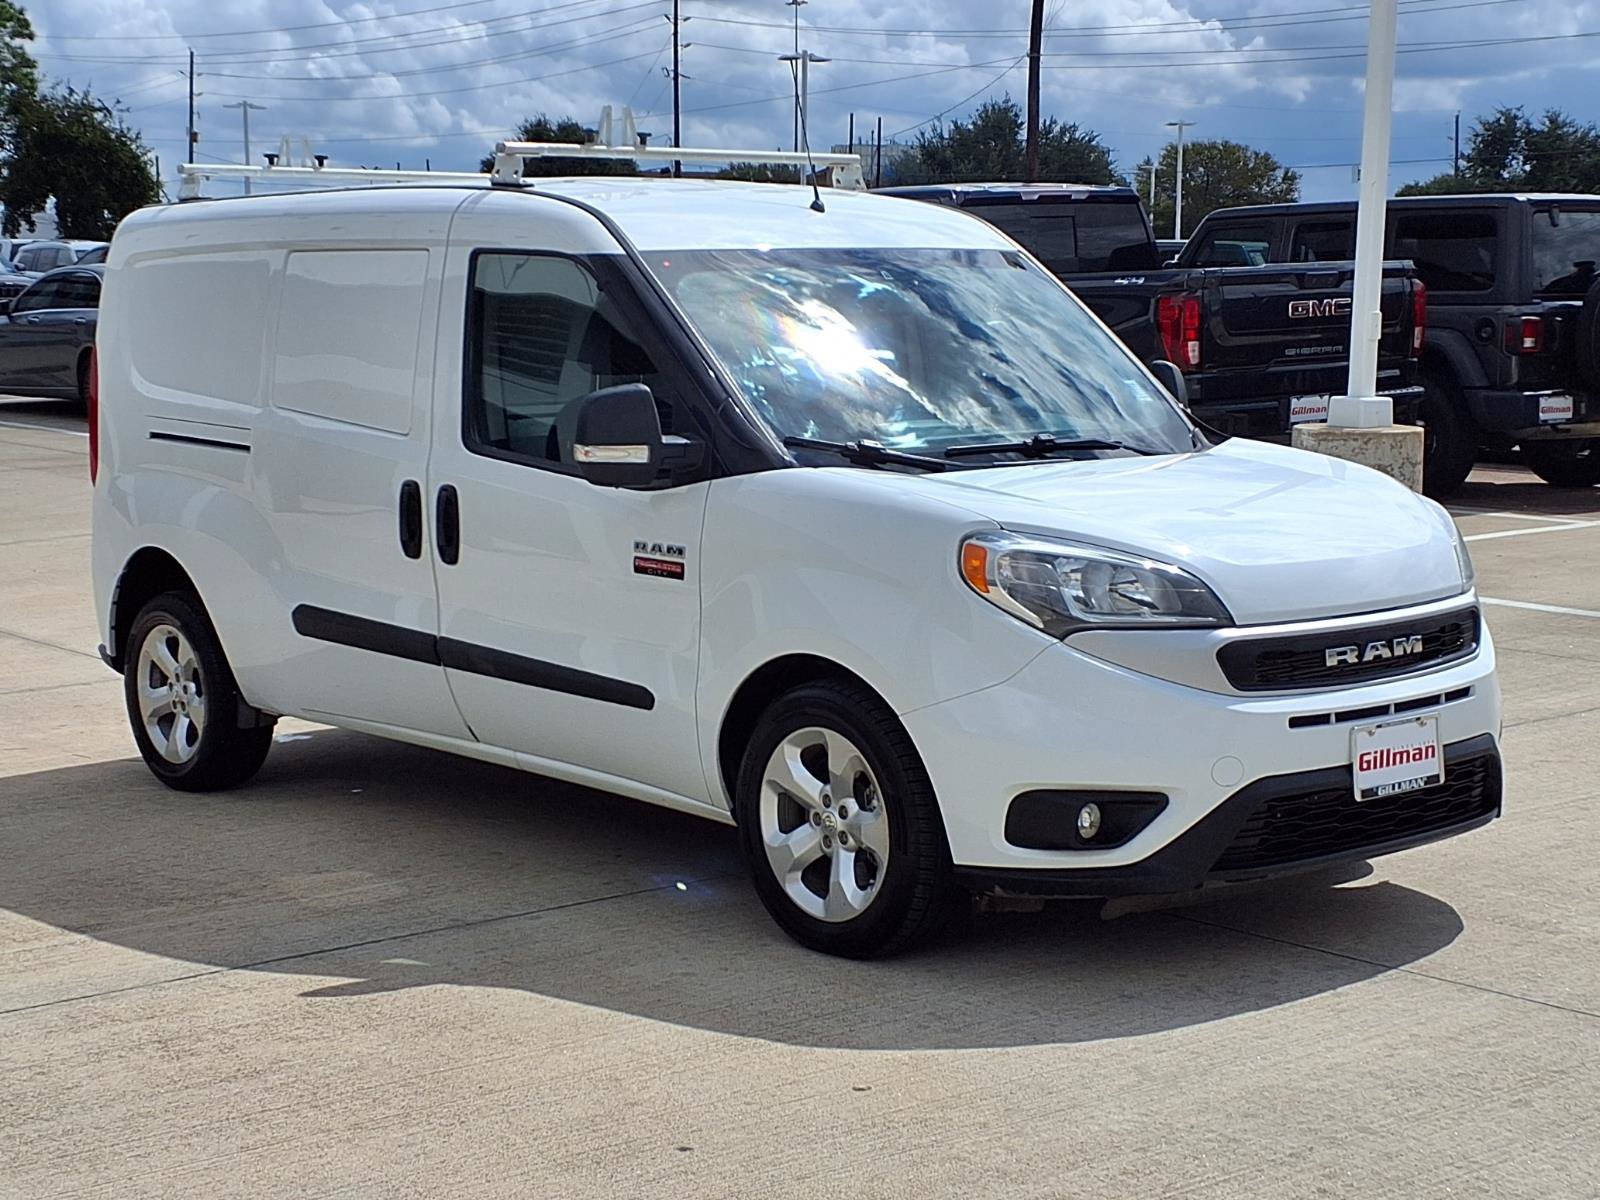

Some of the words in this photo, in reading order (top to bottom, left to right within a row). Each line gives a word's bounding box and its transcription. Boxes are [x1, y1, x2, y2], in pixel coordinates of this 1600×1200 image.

[1288, 298, 1351, 318] GMC
[1291, 406, 1328, 416] Gillman
[634, 541, 687, 558] RAM
[1325, 635, 1423, 667] RAM
[1358, 744, 1436, 772] Gillman
[1377, 777, 1425, 796] GILLMAN
